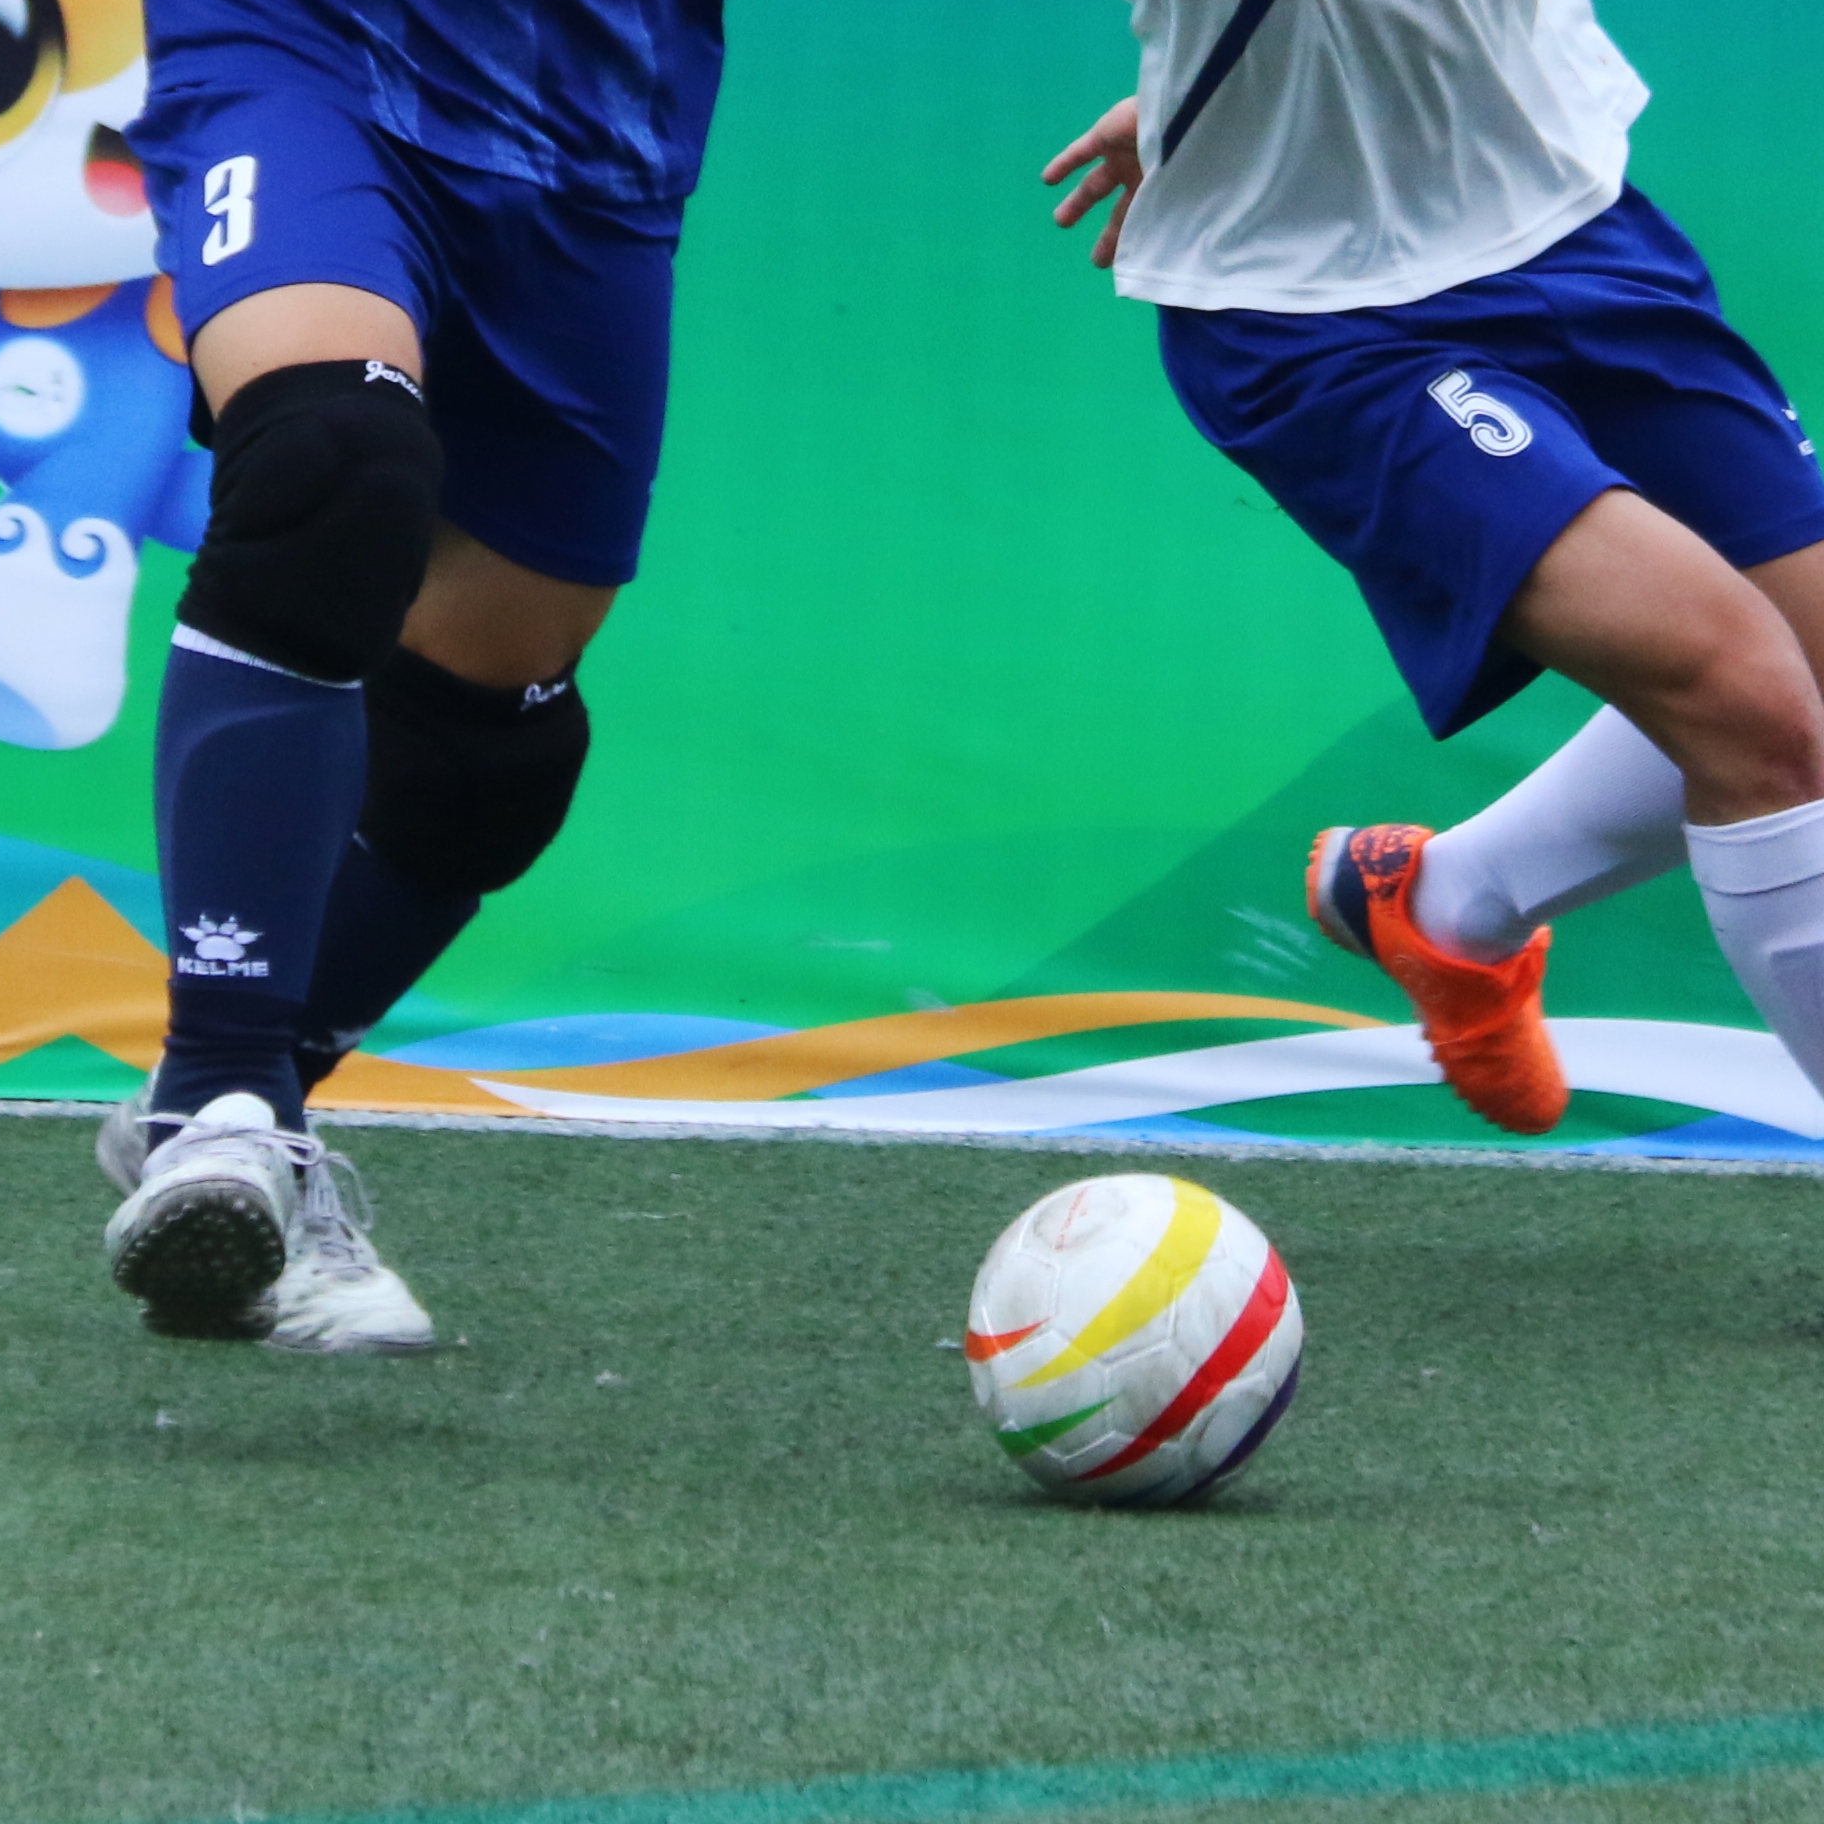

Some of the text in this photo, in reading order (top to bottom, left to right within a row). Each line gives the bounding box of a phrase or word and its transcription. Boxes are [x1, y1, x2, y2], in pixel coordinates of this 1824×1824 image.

[201, 154, 256, 267] 3
[1426, 368, 1534, 458] 5
[176, 955, 270, 978] KELME
